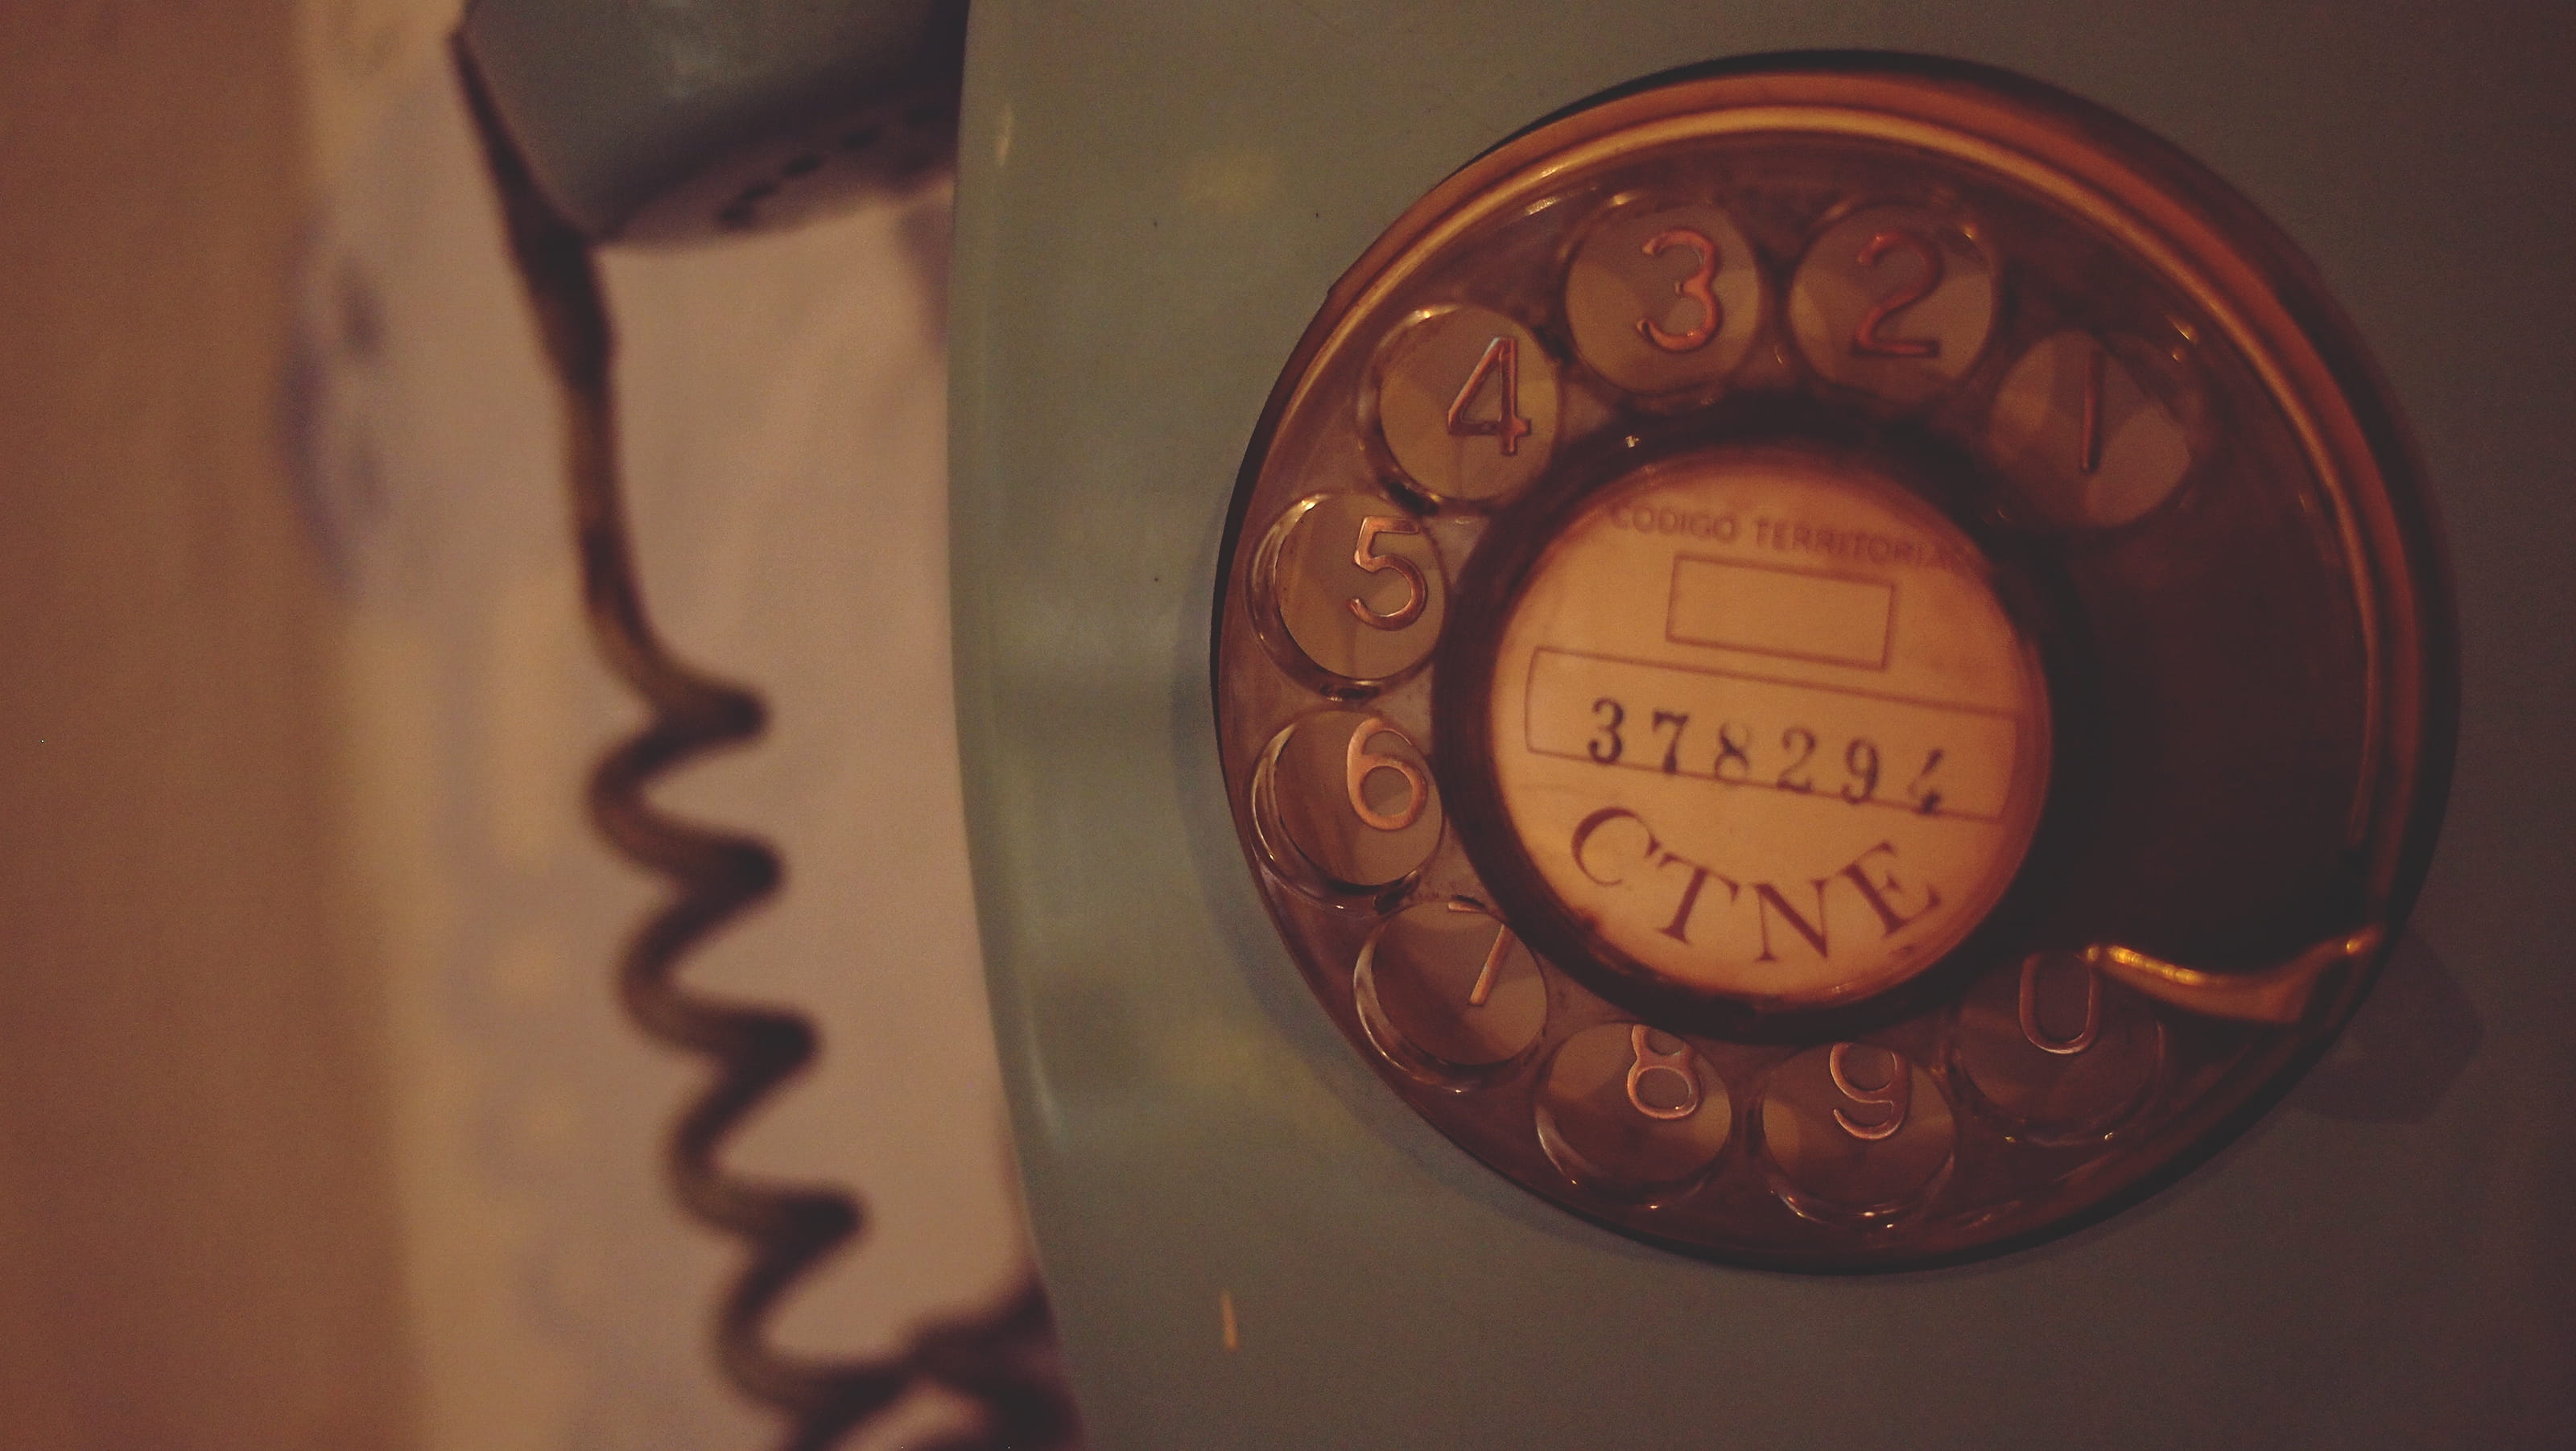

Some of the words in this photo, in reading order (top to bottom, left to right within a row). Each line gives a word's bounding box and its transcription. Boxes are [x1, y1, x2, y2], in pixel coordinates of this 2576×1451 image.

[1637, 228, 1721, 352] 3
[1854, 231, 1942, 357] 2
[1448, 336, 1529, 455] 4
[2079, 346, 2102, 474] 1
[1347, 516, 1427, 631] 5
[1347, 716, 1427, 831] 6
[1587, 698, 1944, 816] 378294
[1571, 806, 1941, 963] CTNE
[1448, 897, 1513, 1005] 7
[1627, 1024, 1701, 1119] 8
[1830, 1042, 1909, 1140] 9
